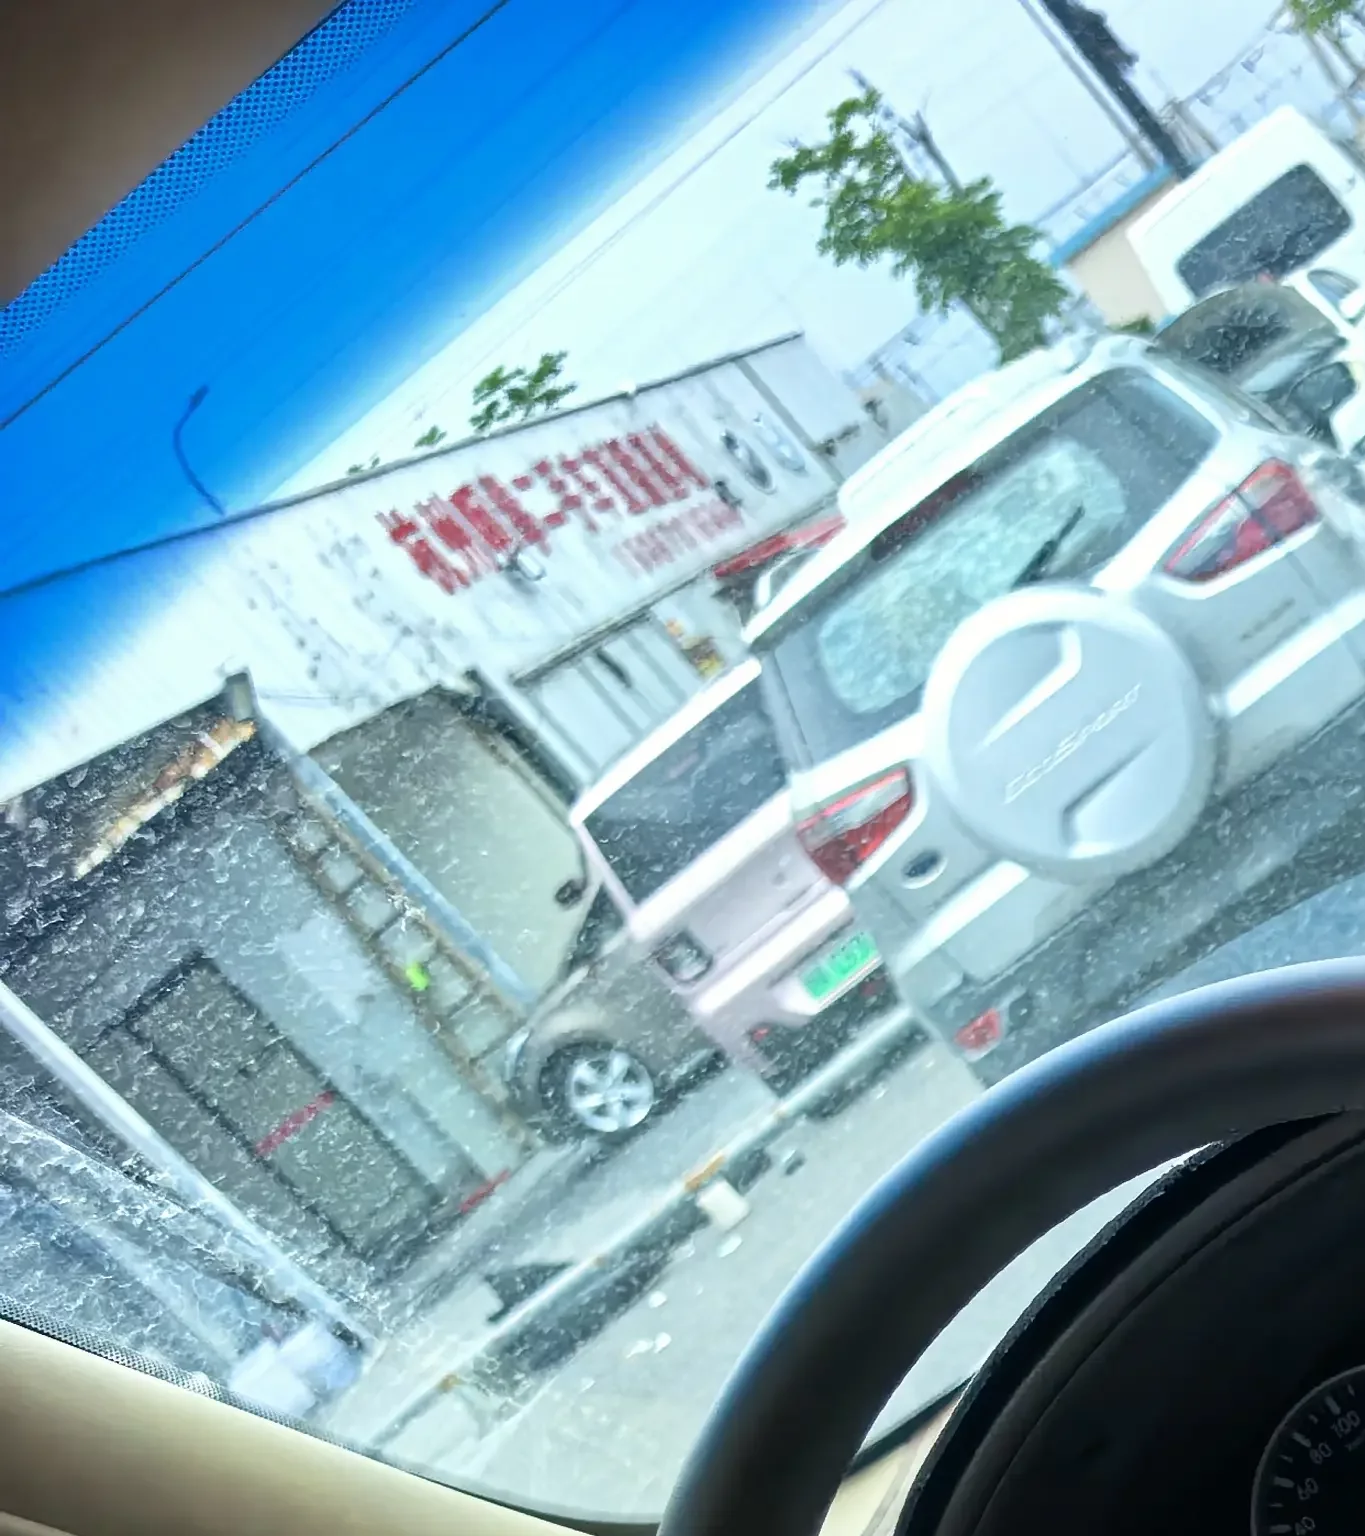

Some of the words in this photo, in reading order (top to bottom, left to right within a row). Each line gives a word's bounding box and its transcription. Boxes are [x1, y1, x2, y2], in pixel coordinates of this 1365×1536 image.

[1331, 1411, 1361, 1438] 100
[1296, 1478, 1319, 1501] 60
[1294, 1516, 1316, 1536] 40
